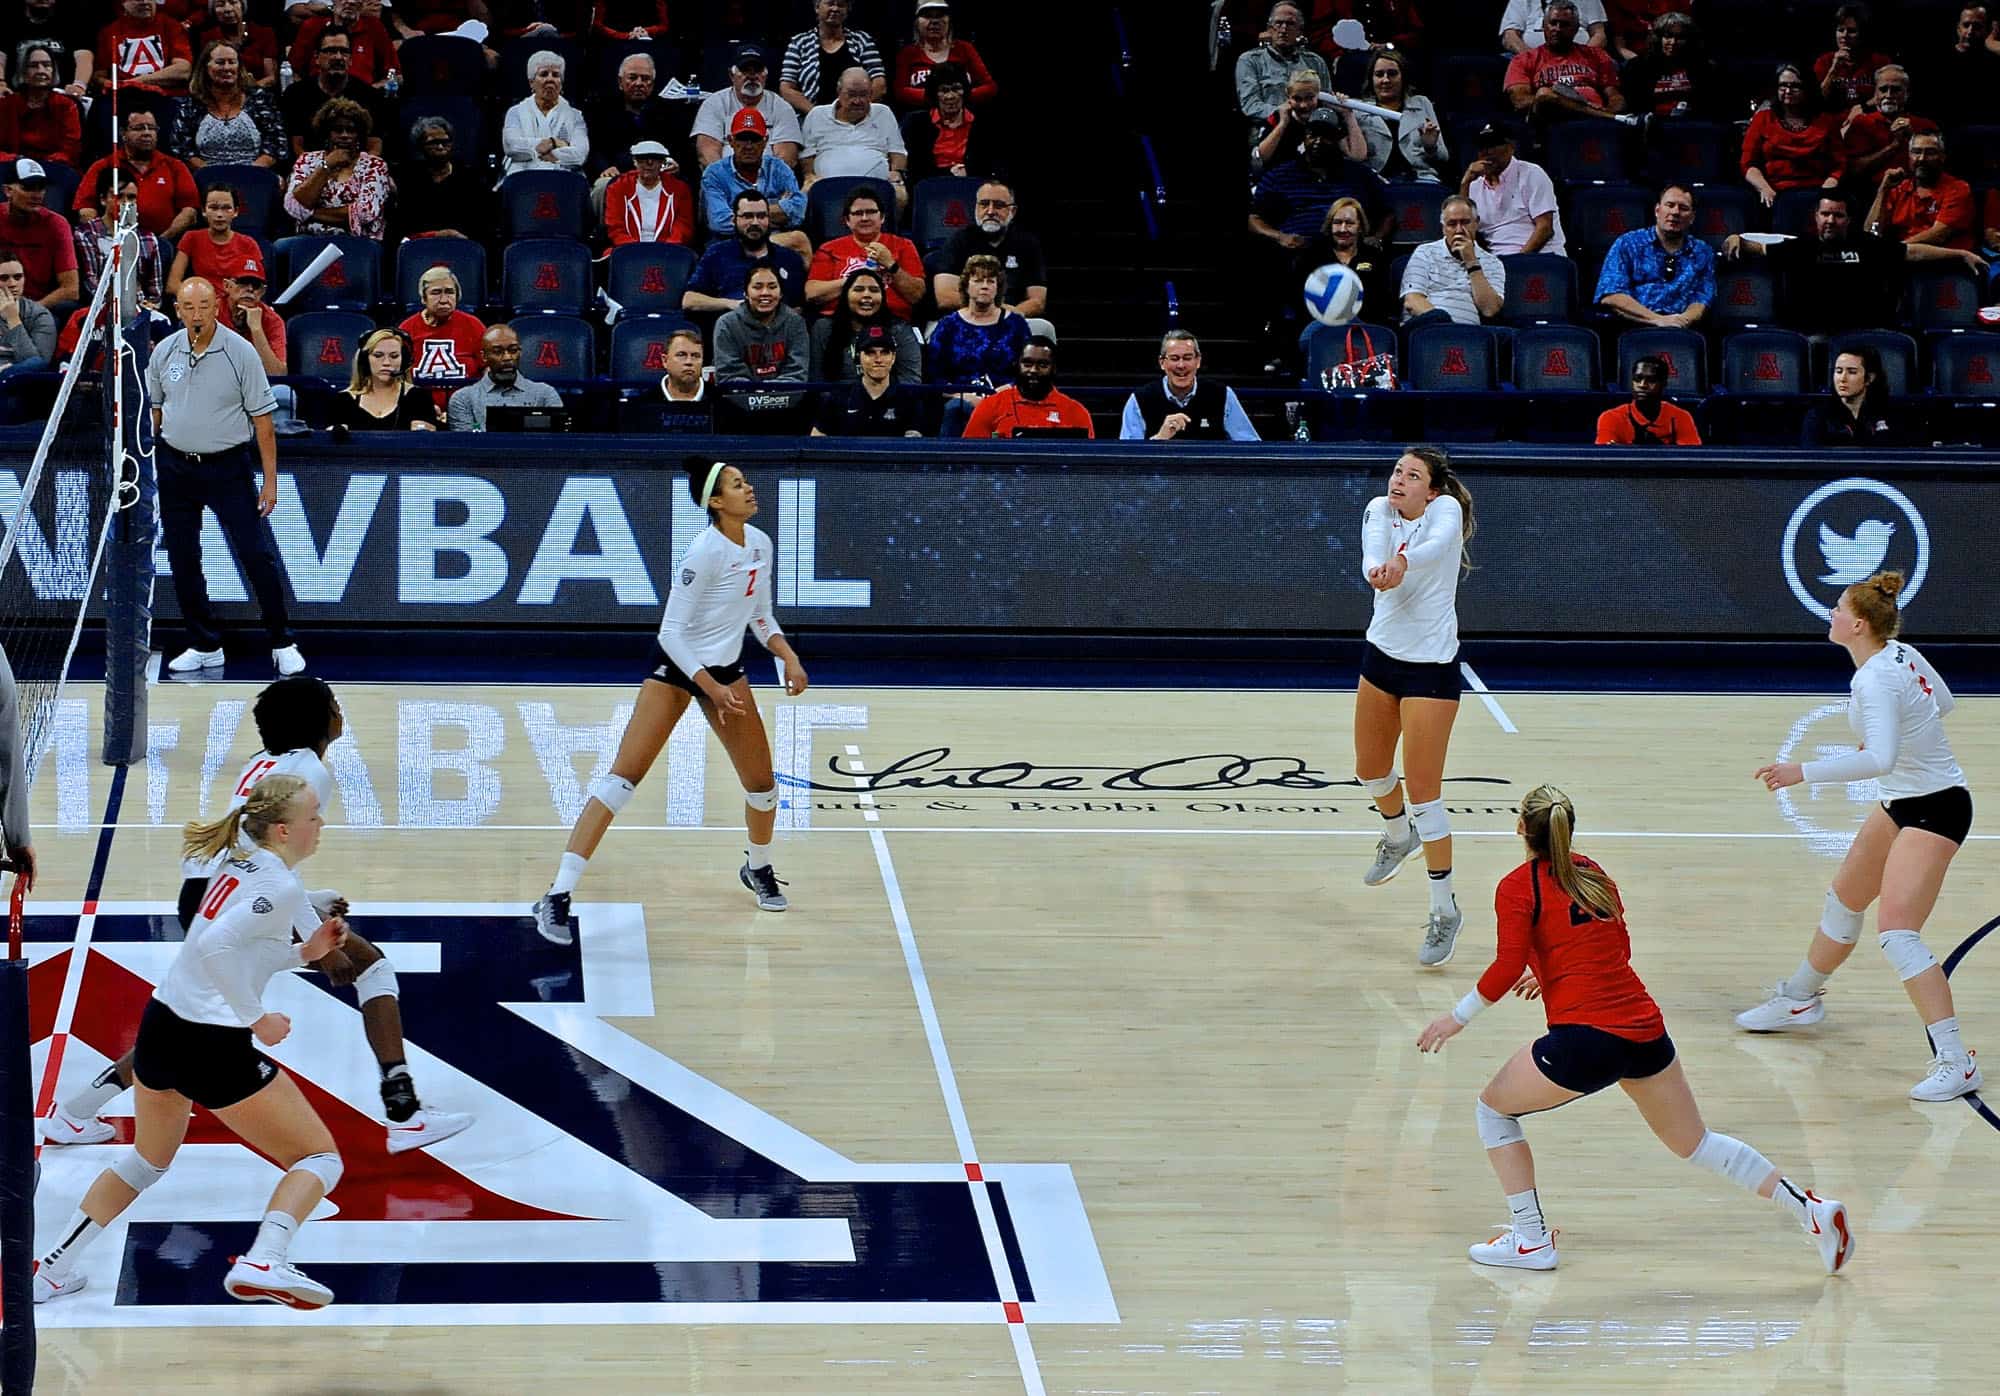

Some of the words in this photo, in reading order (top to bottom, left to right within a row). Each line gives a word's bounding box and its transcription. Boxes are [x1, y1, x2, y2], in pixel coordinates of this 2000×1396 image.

[413, 339, 467, 379] A
[535, 341, 561, 368] A
[1543, 348, 1571, 376] A
[1754, 353, 1784, 380] A
[925, 800, 978, 811] &
[1011, 800, 1161, 813] Bobbi
[1185, 802, 1339, 814] Olson
